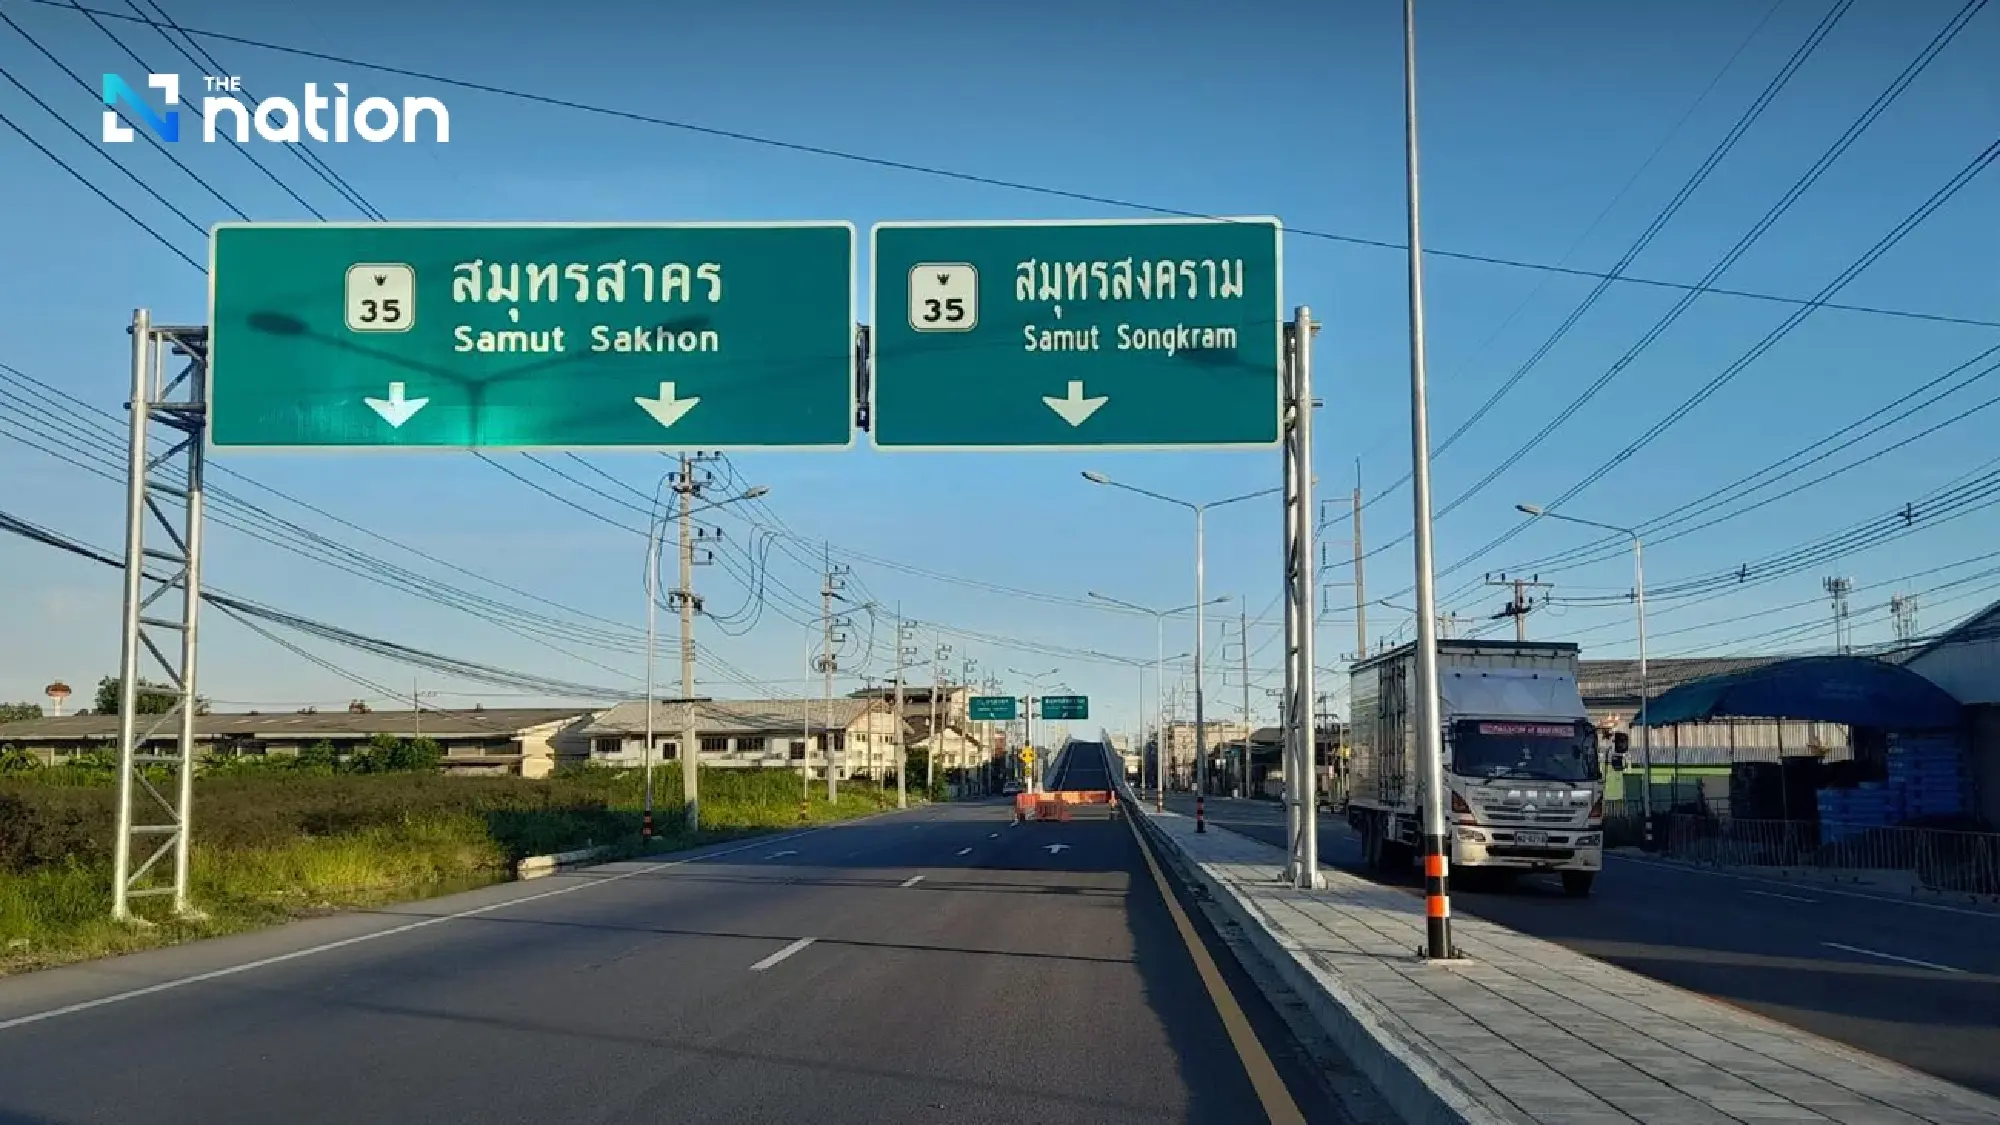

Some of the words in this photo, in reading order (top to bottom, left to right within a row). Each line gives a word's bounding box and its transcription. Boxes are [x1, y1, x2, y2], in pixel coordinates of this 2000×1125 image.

[453, 259, 722, 322] สมุทรสาคร
[1015, 257, 1244, 318] สมุทรสงคราม
[359, 299, 401, 322] 35
[923, 298, 965, 322] 35
[454, 325, 565, 353] Samut
[590, 325, 719, 353] Sakhon
[1023, 324, 1100, 352] Samut
[1117, 323, 1238, 358] Songkram
